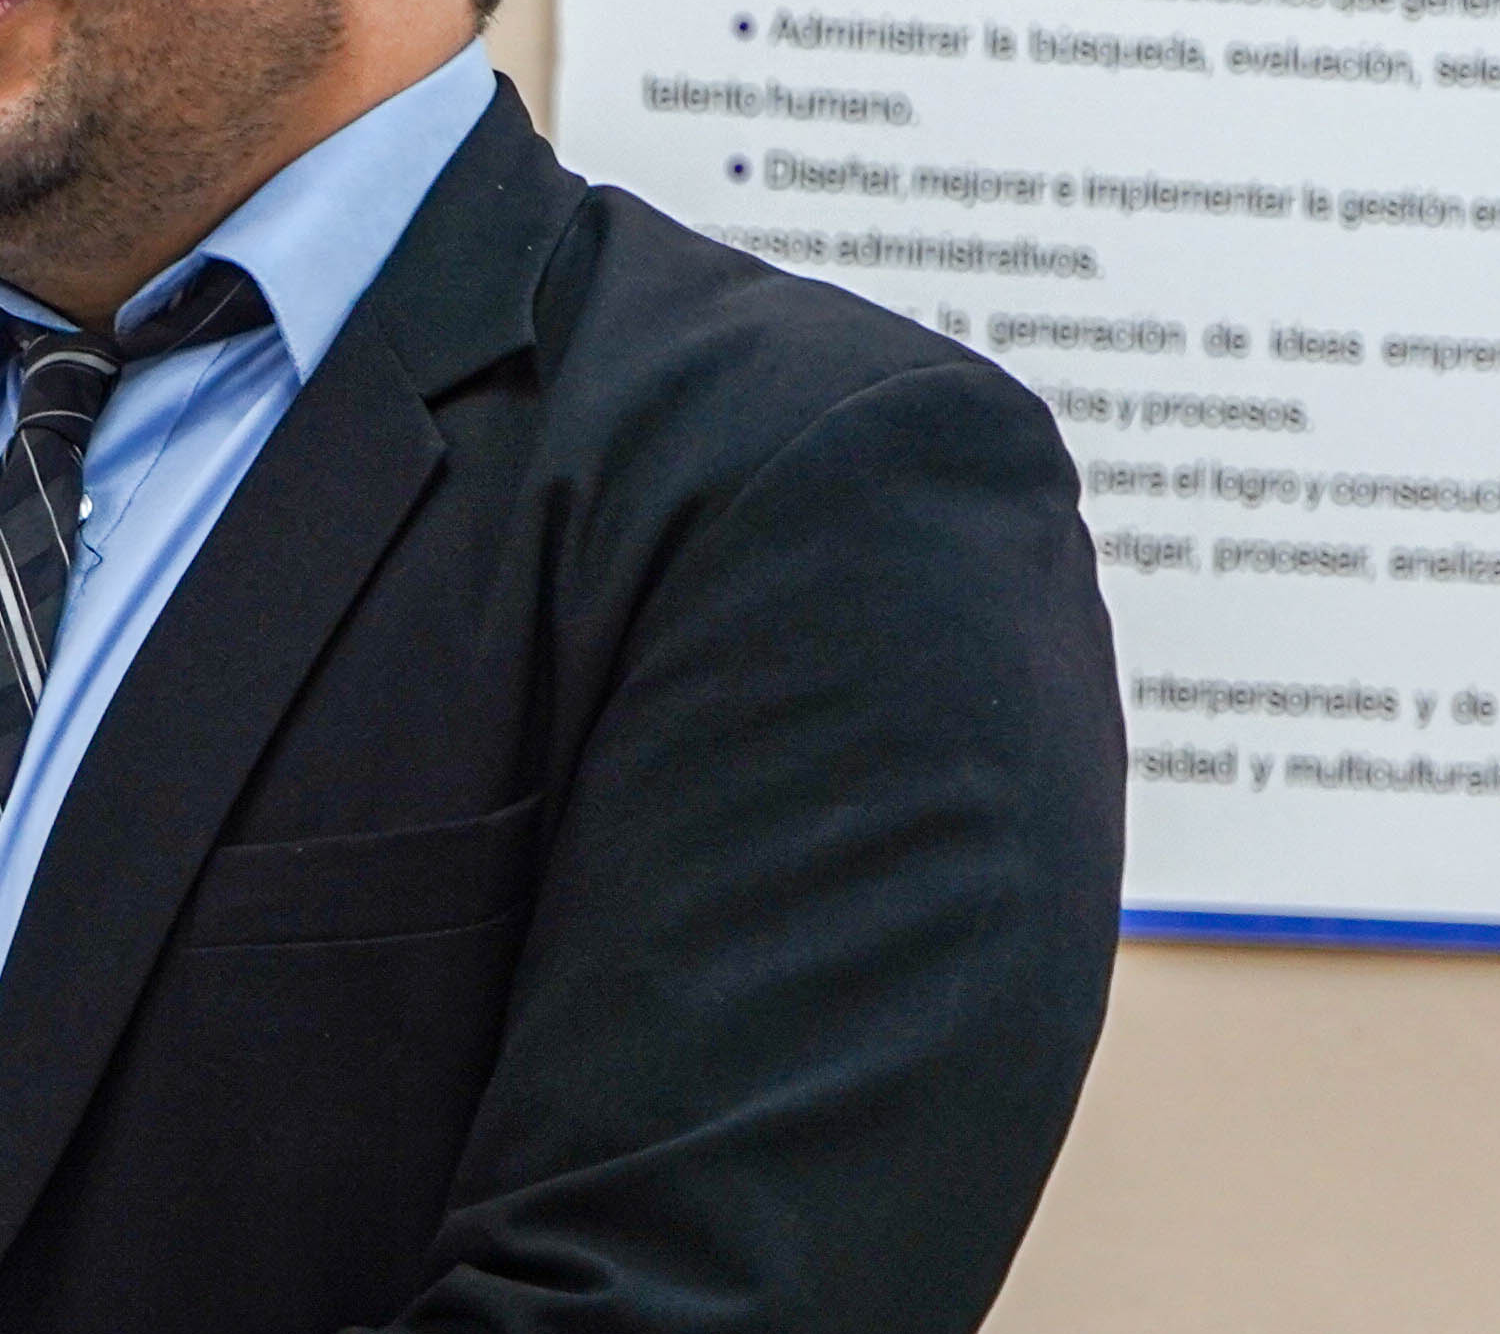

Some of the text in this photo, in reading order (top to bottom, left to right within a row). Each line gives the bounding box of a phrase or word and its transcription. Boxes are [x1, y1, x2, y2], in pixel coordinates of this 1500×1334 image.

[768, 8, 970, 60] Administrar
[1267, 324, 1366, 367] ideas
[1129, 672, 1400, 723] interpersonales
